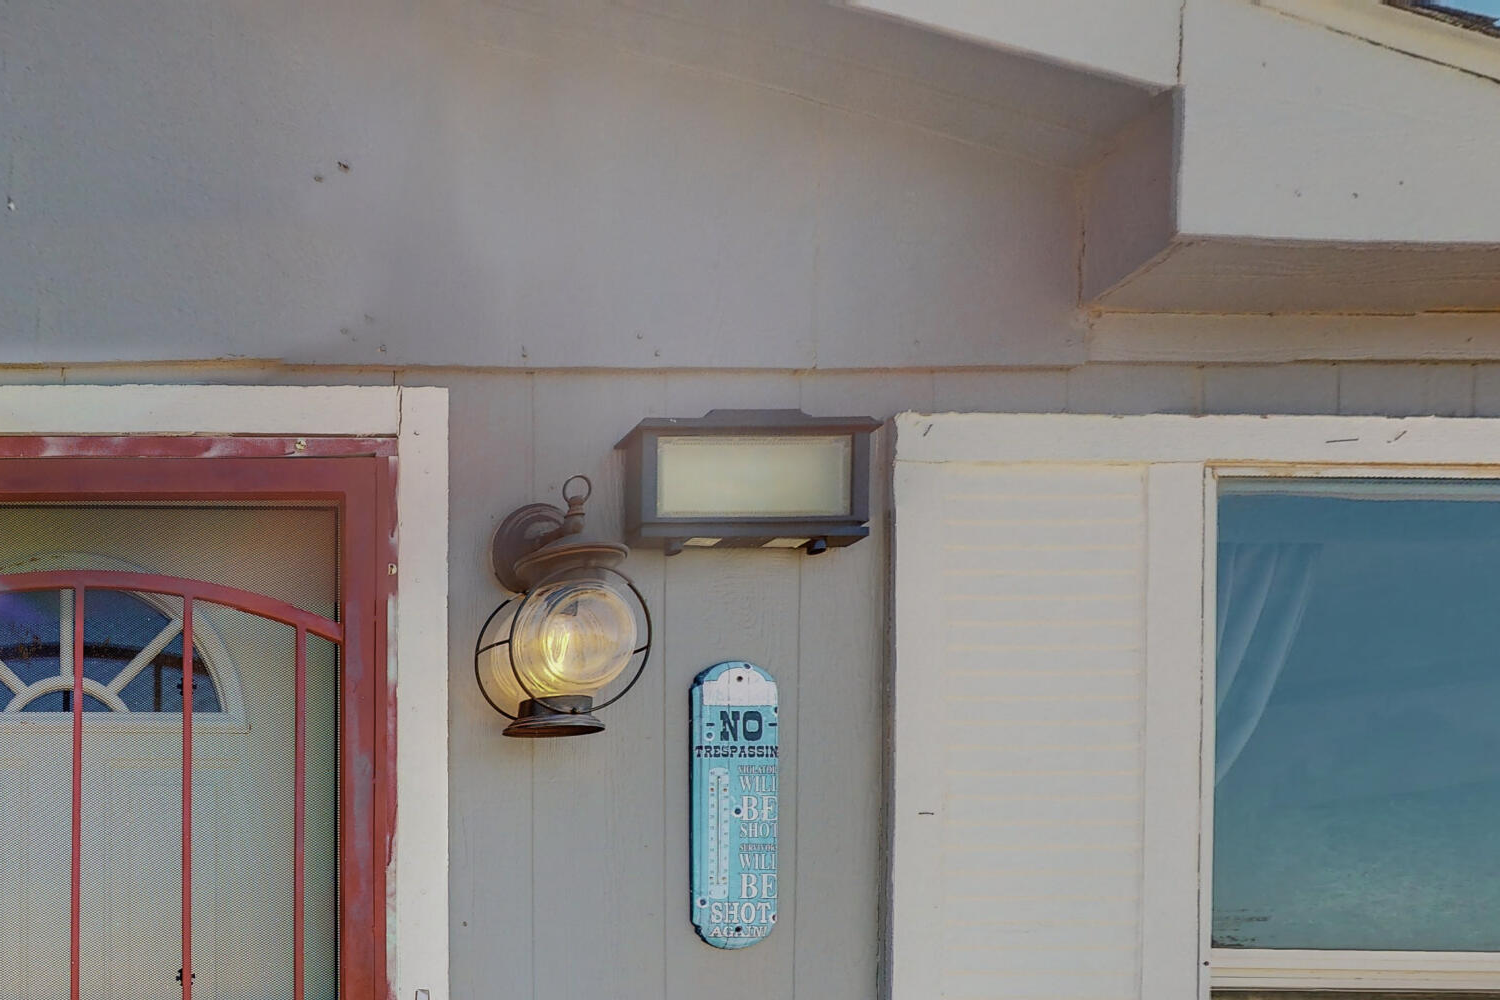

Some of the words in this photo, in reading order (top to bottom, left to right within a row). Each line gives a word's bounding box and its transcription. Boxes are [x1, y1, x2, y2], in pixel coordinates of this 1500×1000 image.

[720, 711, 762, 741] NO
[740, 795, 777, 821] BE
[740, 873, 777, 899] BE
[711, 902, 771, 923] SHOT
